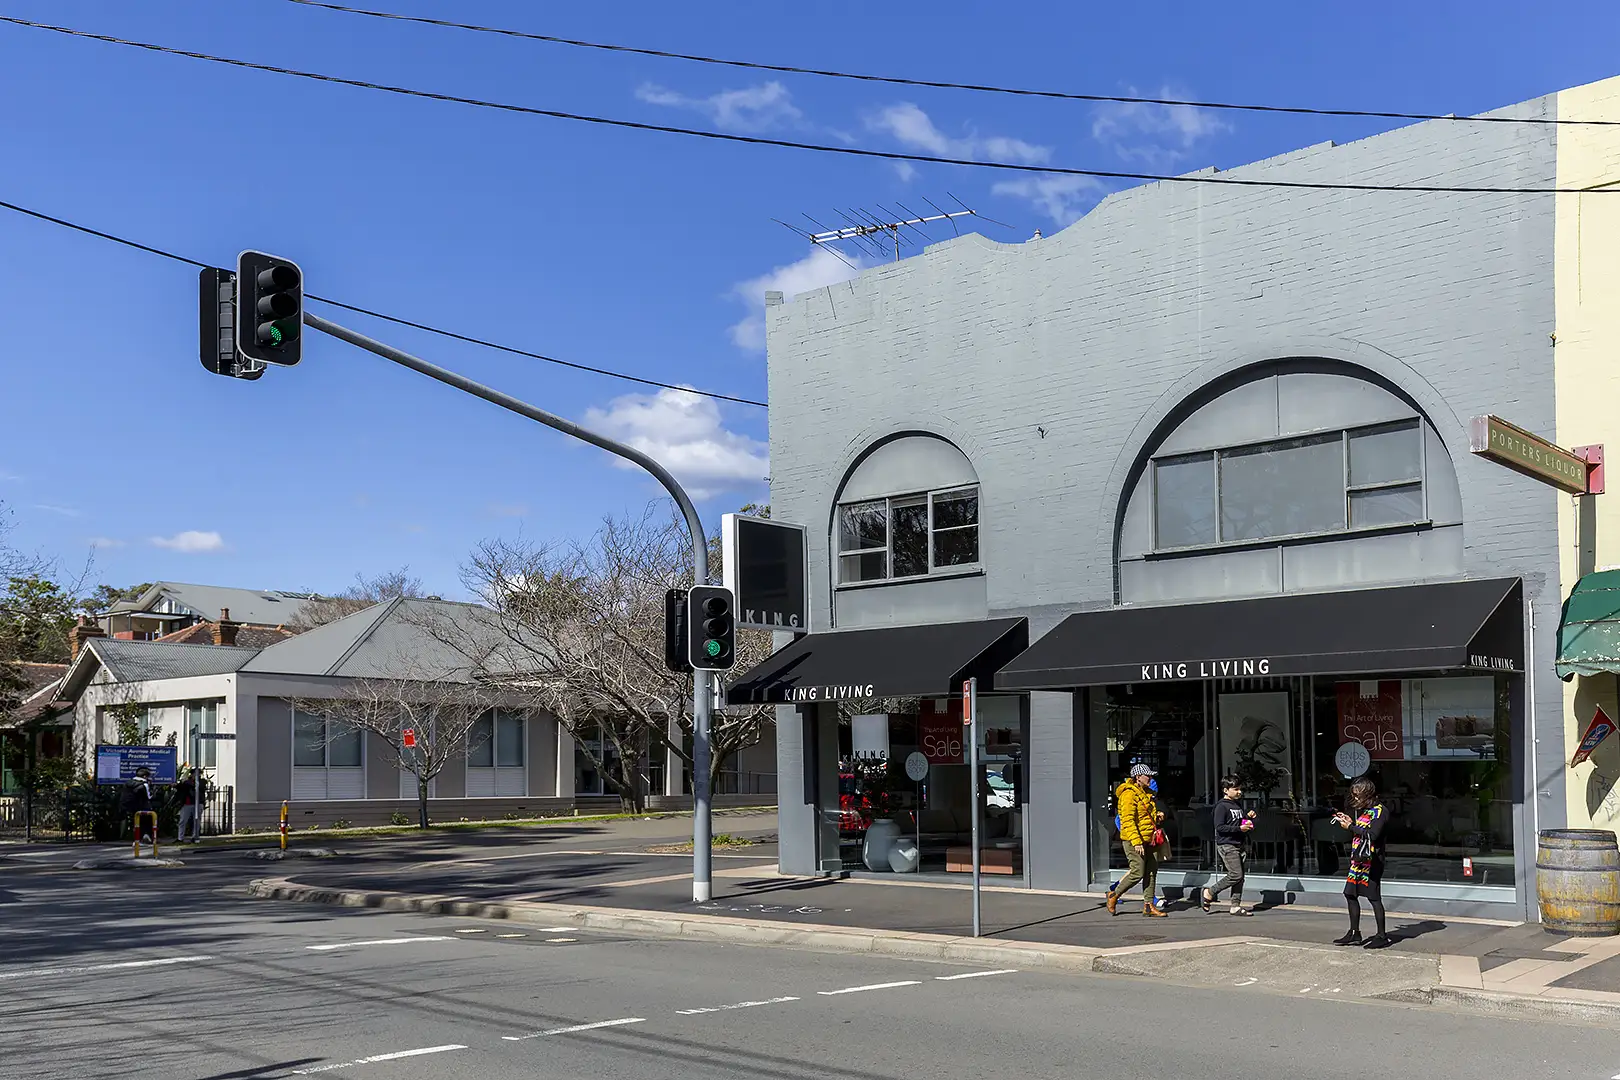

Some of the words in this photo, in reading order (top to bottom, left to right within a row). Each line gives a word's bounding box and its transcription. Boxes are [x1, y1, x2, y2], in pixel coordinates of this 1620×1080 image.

[1491, 429, 1541, 462] PORTERS
[1545, 454, 1582, 481] LIQUOR
[745, 609, 799, 627] KING
[1141, 663, 1187, 680] KING
[1200, 659, 1269, 677] LIVING
[1470, 654, 1488, 667] KING
[1490, 656, 1514, 670] LIVING
[784, 687, 817, 701] KING
[825, 684, 874, 699] LIVING
[1374, 714, 1394, 722] Living
[923, 735, 961, 757] Sale
[1343, 724, 1399, 751] Sale
[855, 750, 887, 759] KING
[1339, 751, 1366, 760] ENDS
